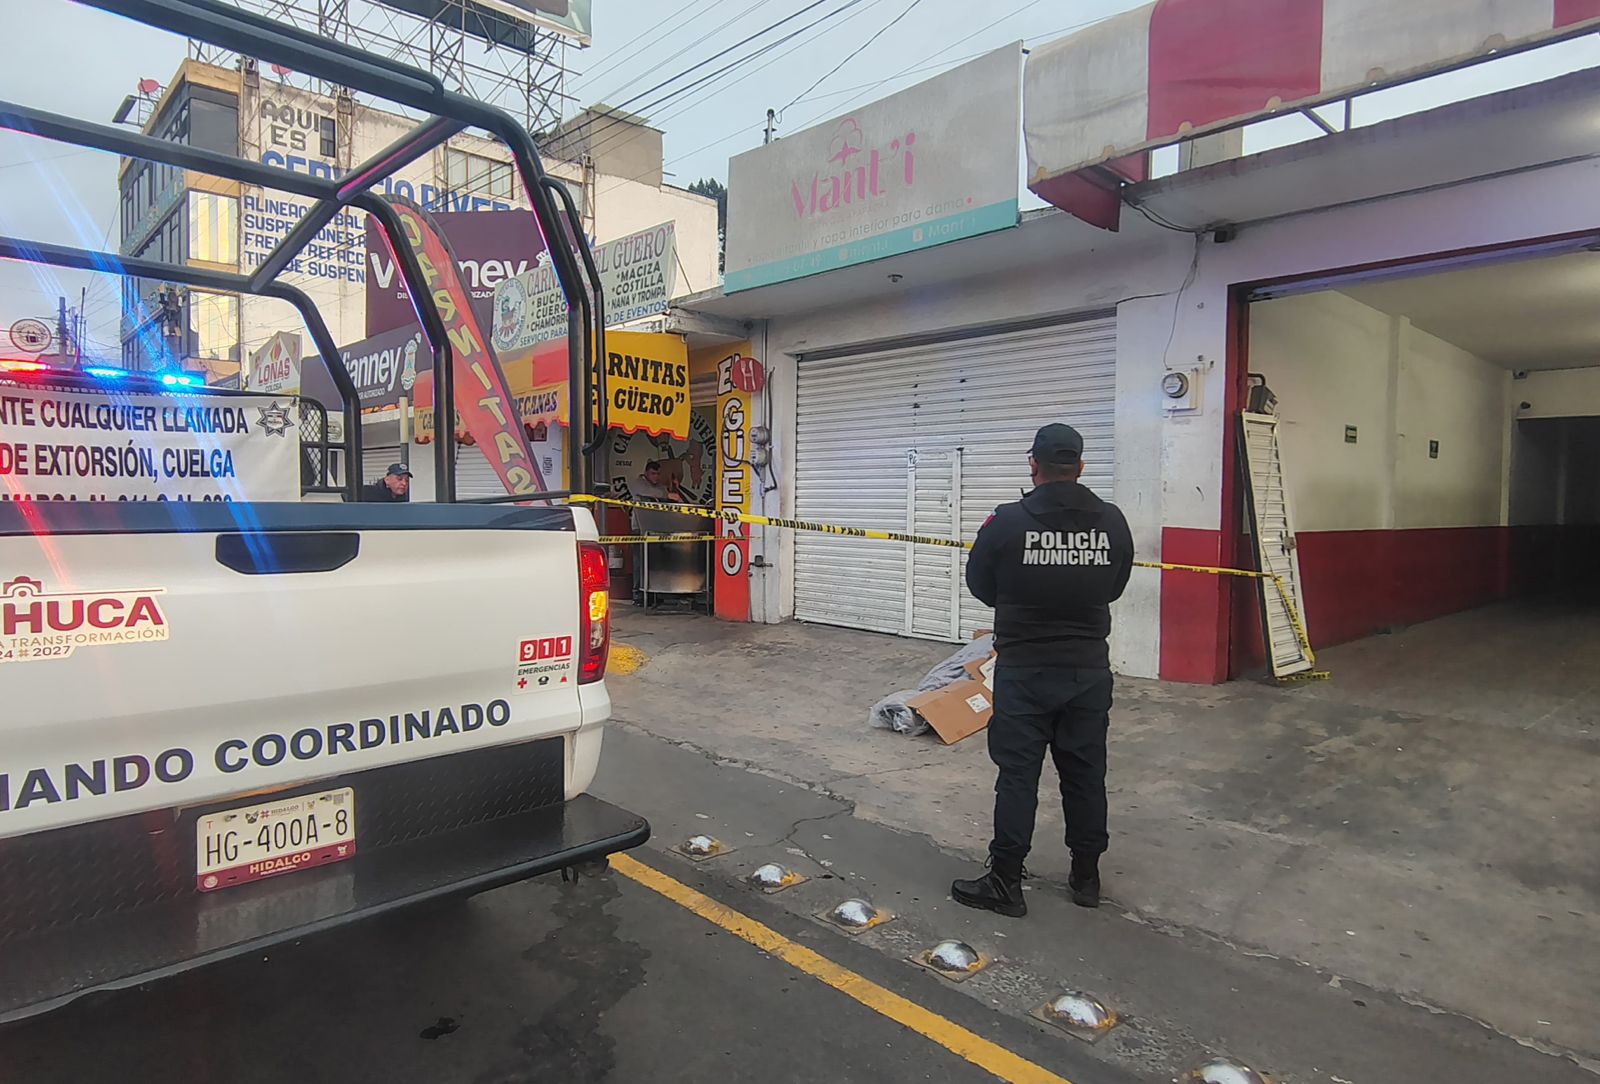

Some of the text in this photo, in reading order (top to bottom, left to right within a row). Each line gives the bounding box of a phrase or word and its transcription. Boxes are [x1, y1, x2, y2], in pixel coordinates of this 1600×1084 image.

[261, 100, 319, 132] AQUI
[271, 124, 306, 151] ES
[620, 260, 661, 282] MACIZA
[615, 273, 664, 296] COSTILLA
[626, 300, 668, 319] EVENTOS
[258, 357, 291, 384] LONAS
[40, 400, 158, 432] CUALQUIER
[162, 406, 249, 434] LLAMADA
[0, 440, 235, 483] DE EXTORSIÓN, CUELGA
[1025, 528, 1111, 550] POLICÍA
[1022, 550, 1111, 566] MUNICIPAL
[11, 627, 165, 648] TRANSFORMACIÓN
[33, 645, 71, 657] 2027
[523, 639, 567, 659] 911
[517, 662, 570, 676] EMERGENCIAS
[0, 698, 511, 812] ANDO COORDINADO
[206, 808, 348, 867] HG-400A-8
[249, 852, 312, 874] HIDALGO
